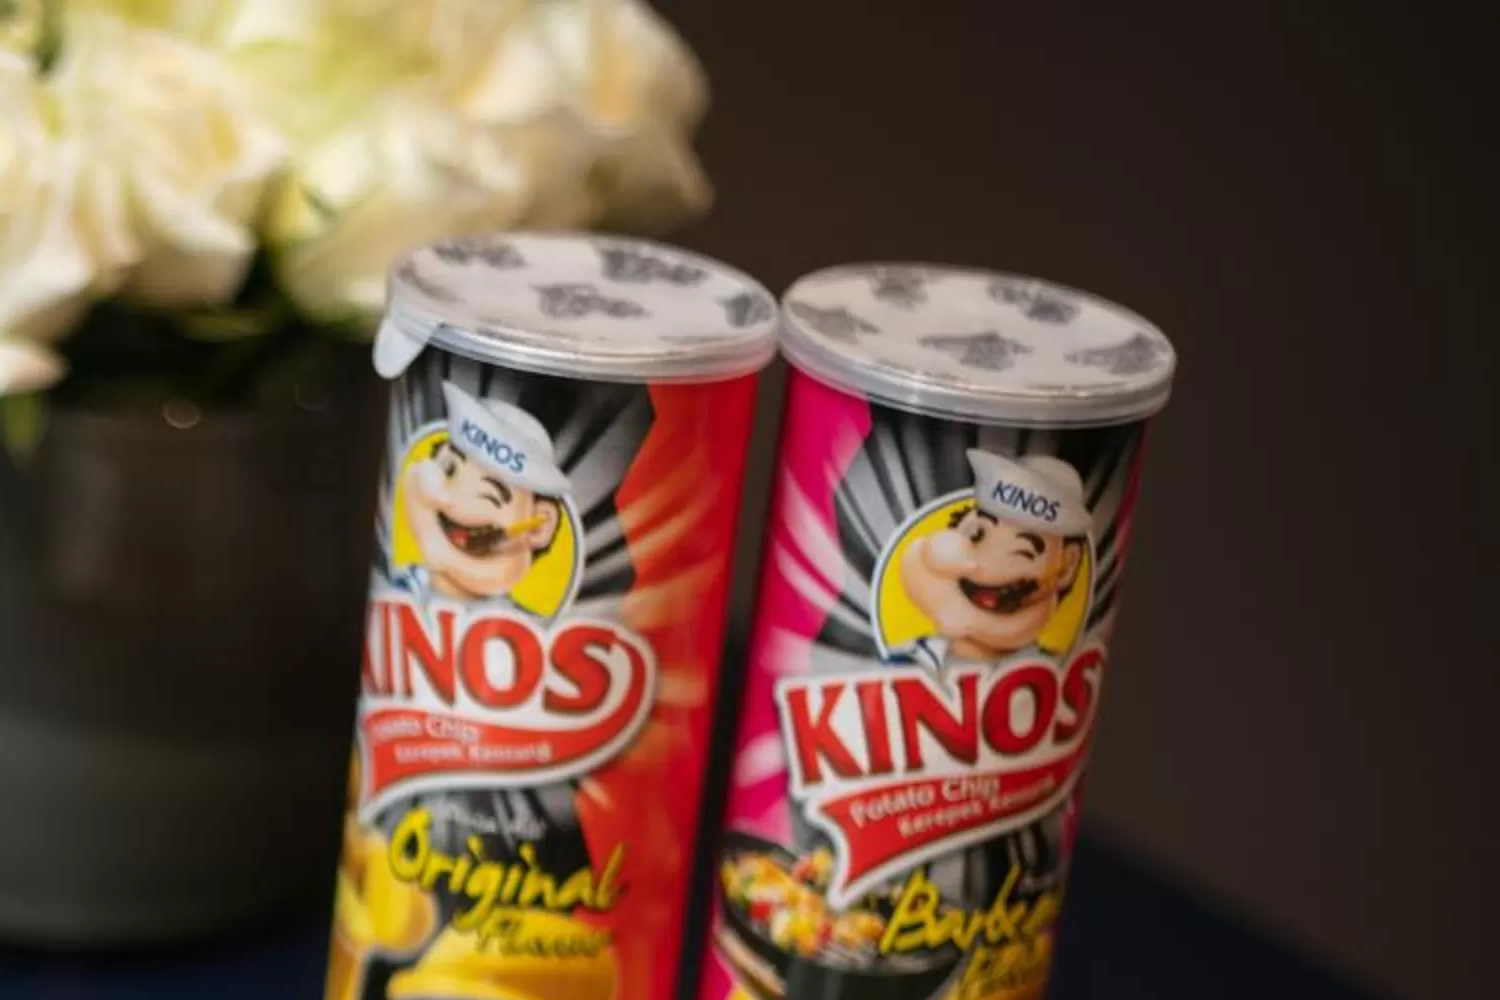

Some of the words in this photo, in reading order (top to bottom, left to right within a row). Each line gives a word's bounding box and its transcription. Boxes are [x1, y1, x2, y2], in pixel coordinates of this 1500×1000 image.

[461, 418, 526, 473] KINOS
[991, 480, 1061, 522] KINOS
[785, 647, 1104, 786] KINOS
[848, 782, 935, 829] Potato
[941, 773, 1001, 803] Chip
[388, 807, 630, 933] Original
